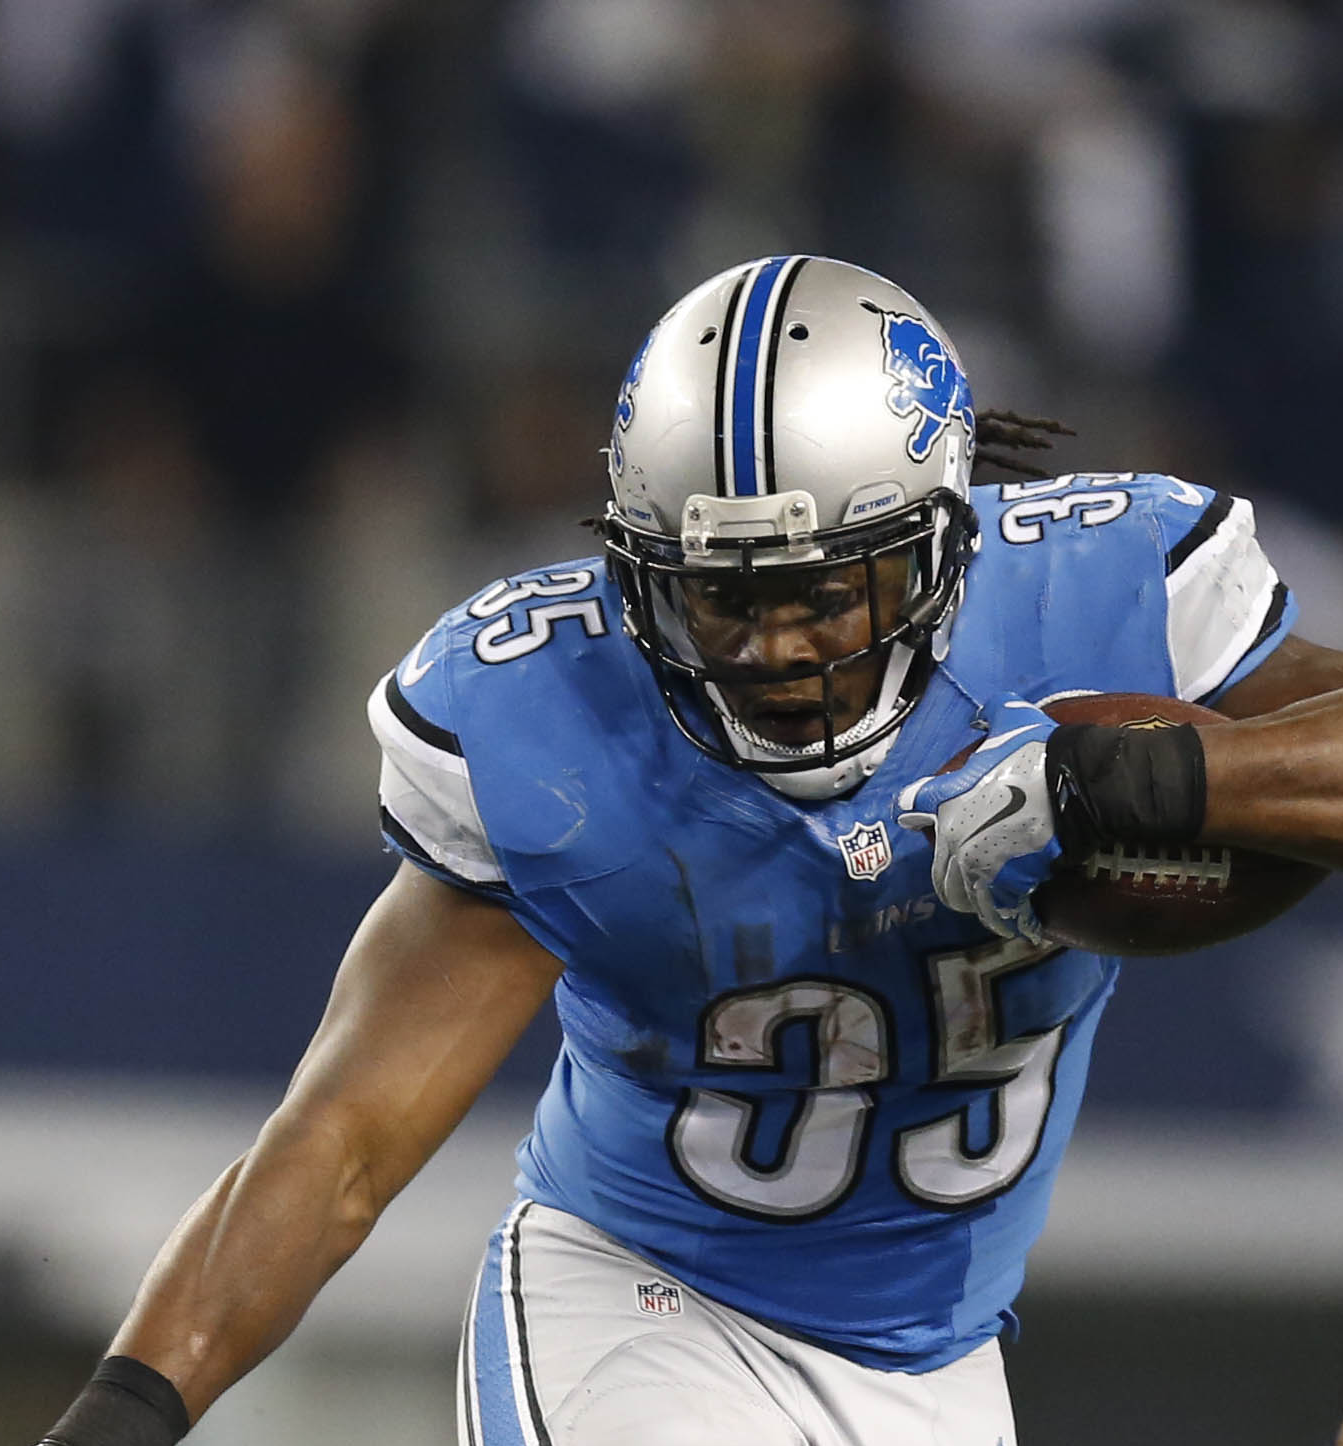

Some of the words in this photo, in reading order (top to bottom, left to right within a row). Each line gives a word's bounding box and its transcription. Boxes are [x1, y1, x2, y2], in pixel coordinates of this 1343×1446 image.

[853, 493, 898, 514] DETROIT
[468, 570, 609, 665] 35
[853, 847, 885, 872] NFL
[666, 935, 1072, 1225] 35
[644, 1296, 677, 1312] NFL
